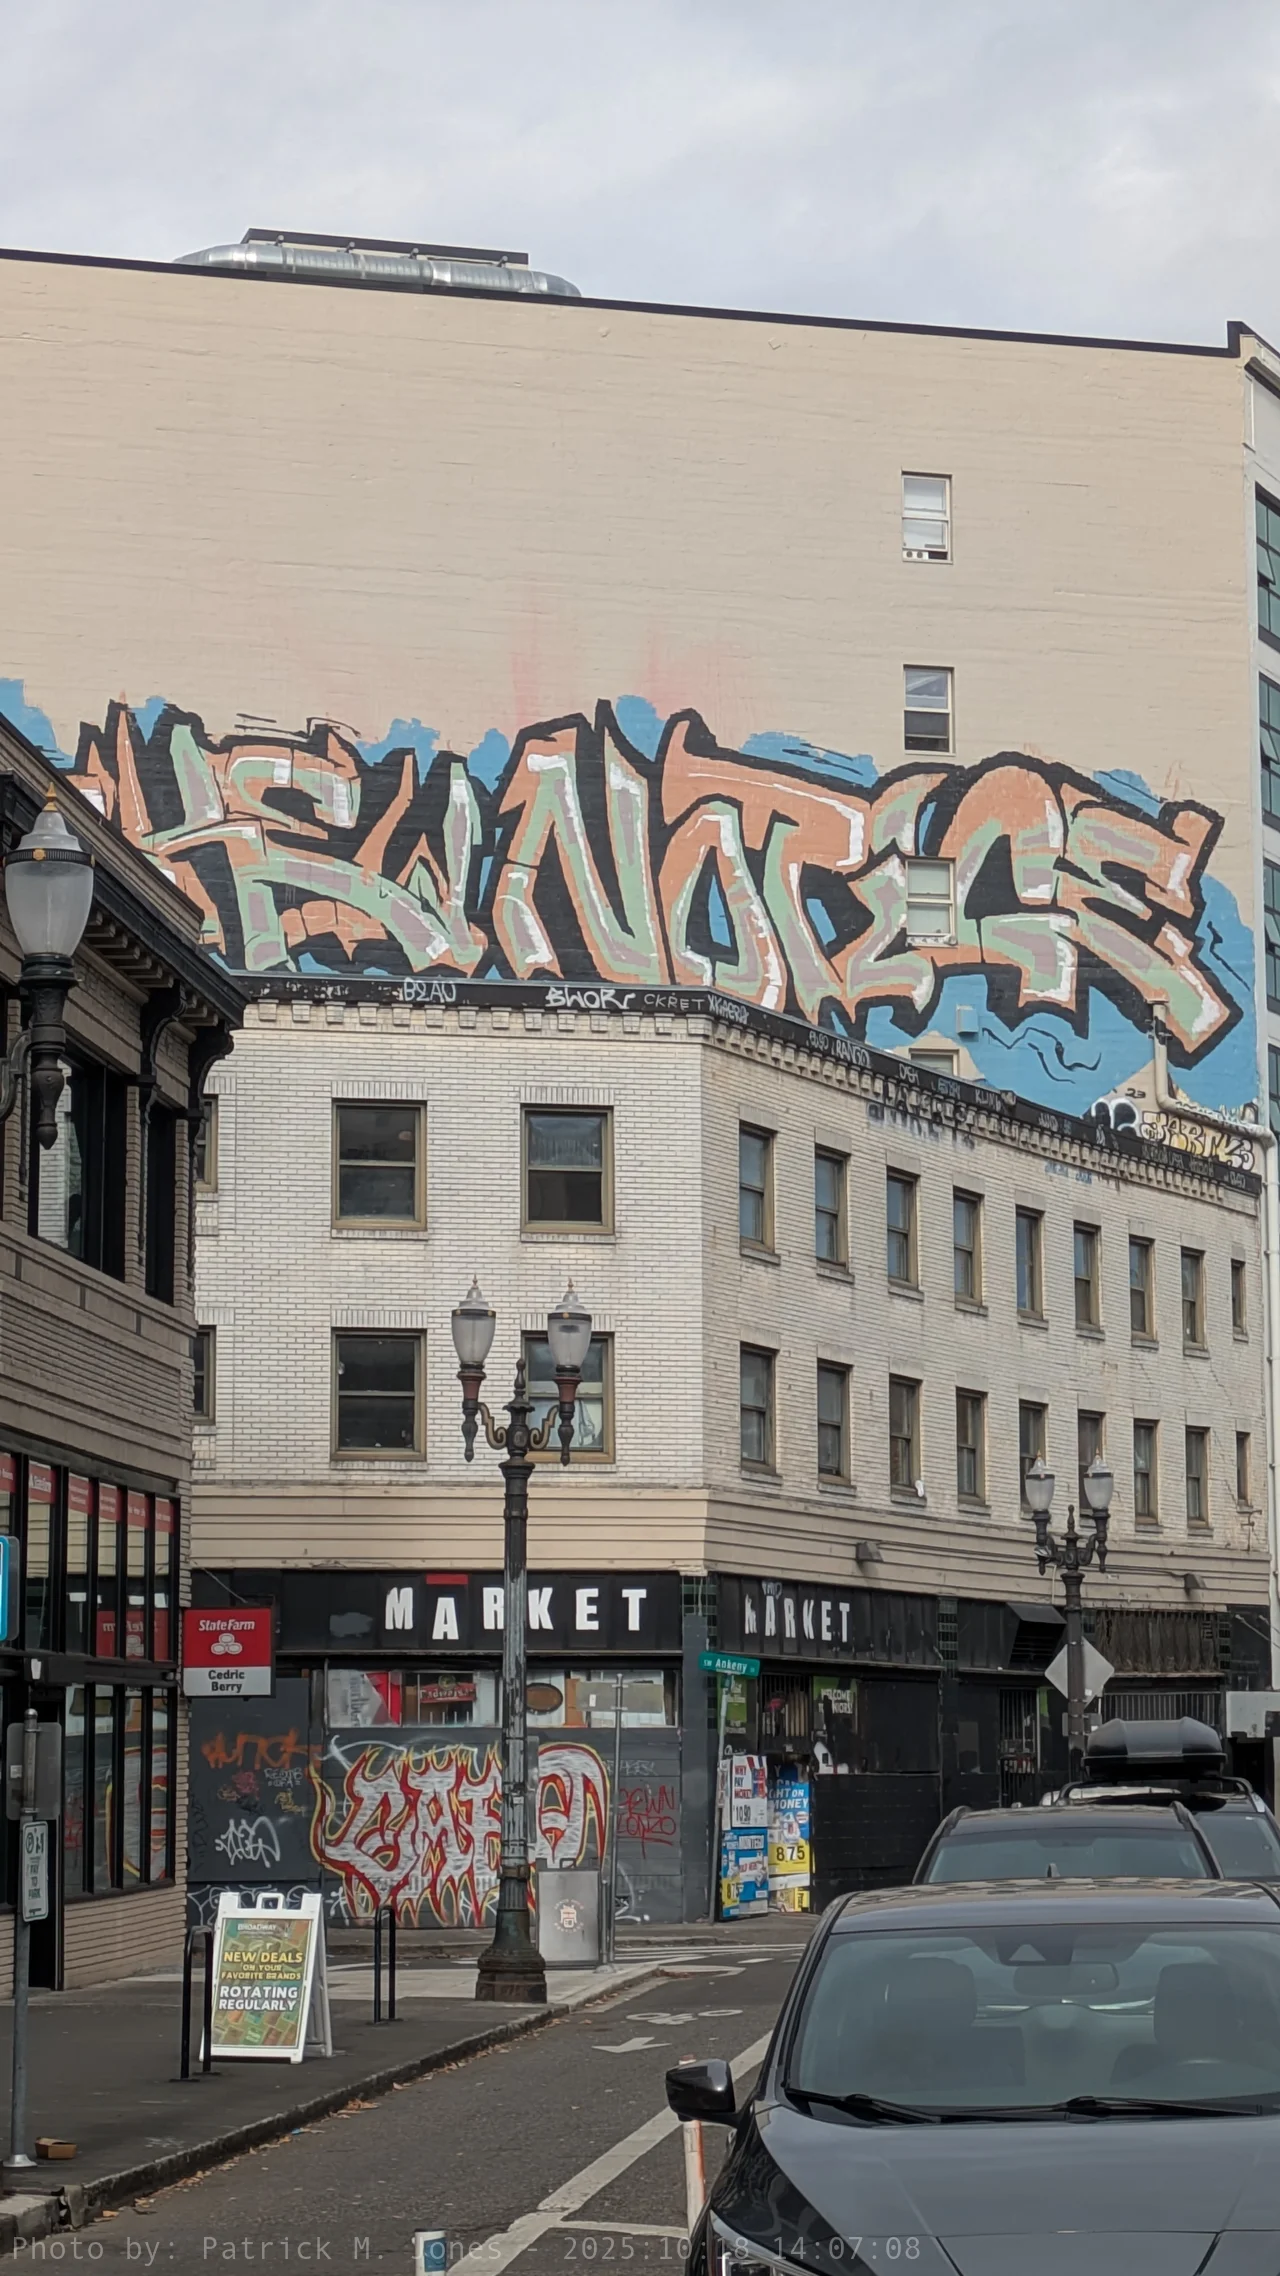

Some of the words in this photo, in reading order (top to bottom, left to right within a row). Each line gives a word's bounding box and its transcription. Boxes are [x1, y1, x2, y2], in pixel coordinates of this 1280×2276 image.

[384, 1586, 648, 1640] MARKET
[715, 1658, 748, 1674] Ankeny
[207, 1669, 246, 1680] Cedric
[210, 1680, 243, 1694] Berry
[223, 1951, 257, 1963] NEW
[261, 1952, 303, 1963] DEALS
[221, 1971, 263, 1980] FAVORITE
[266, 1972, 301, 1980] BRANDS
[220, 1985, 298, 1999] ROTATING
[219, 1998, 297, 2011] REGULARLY
